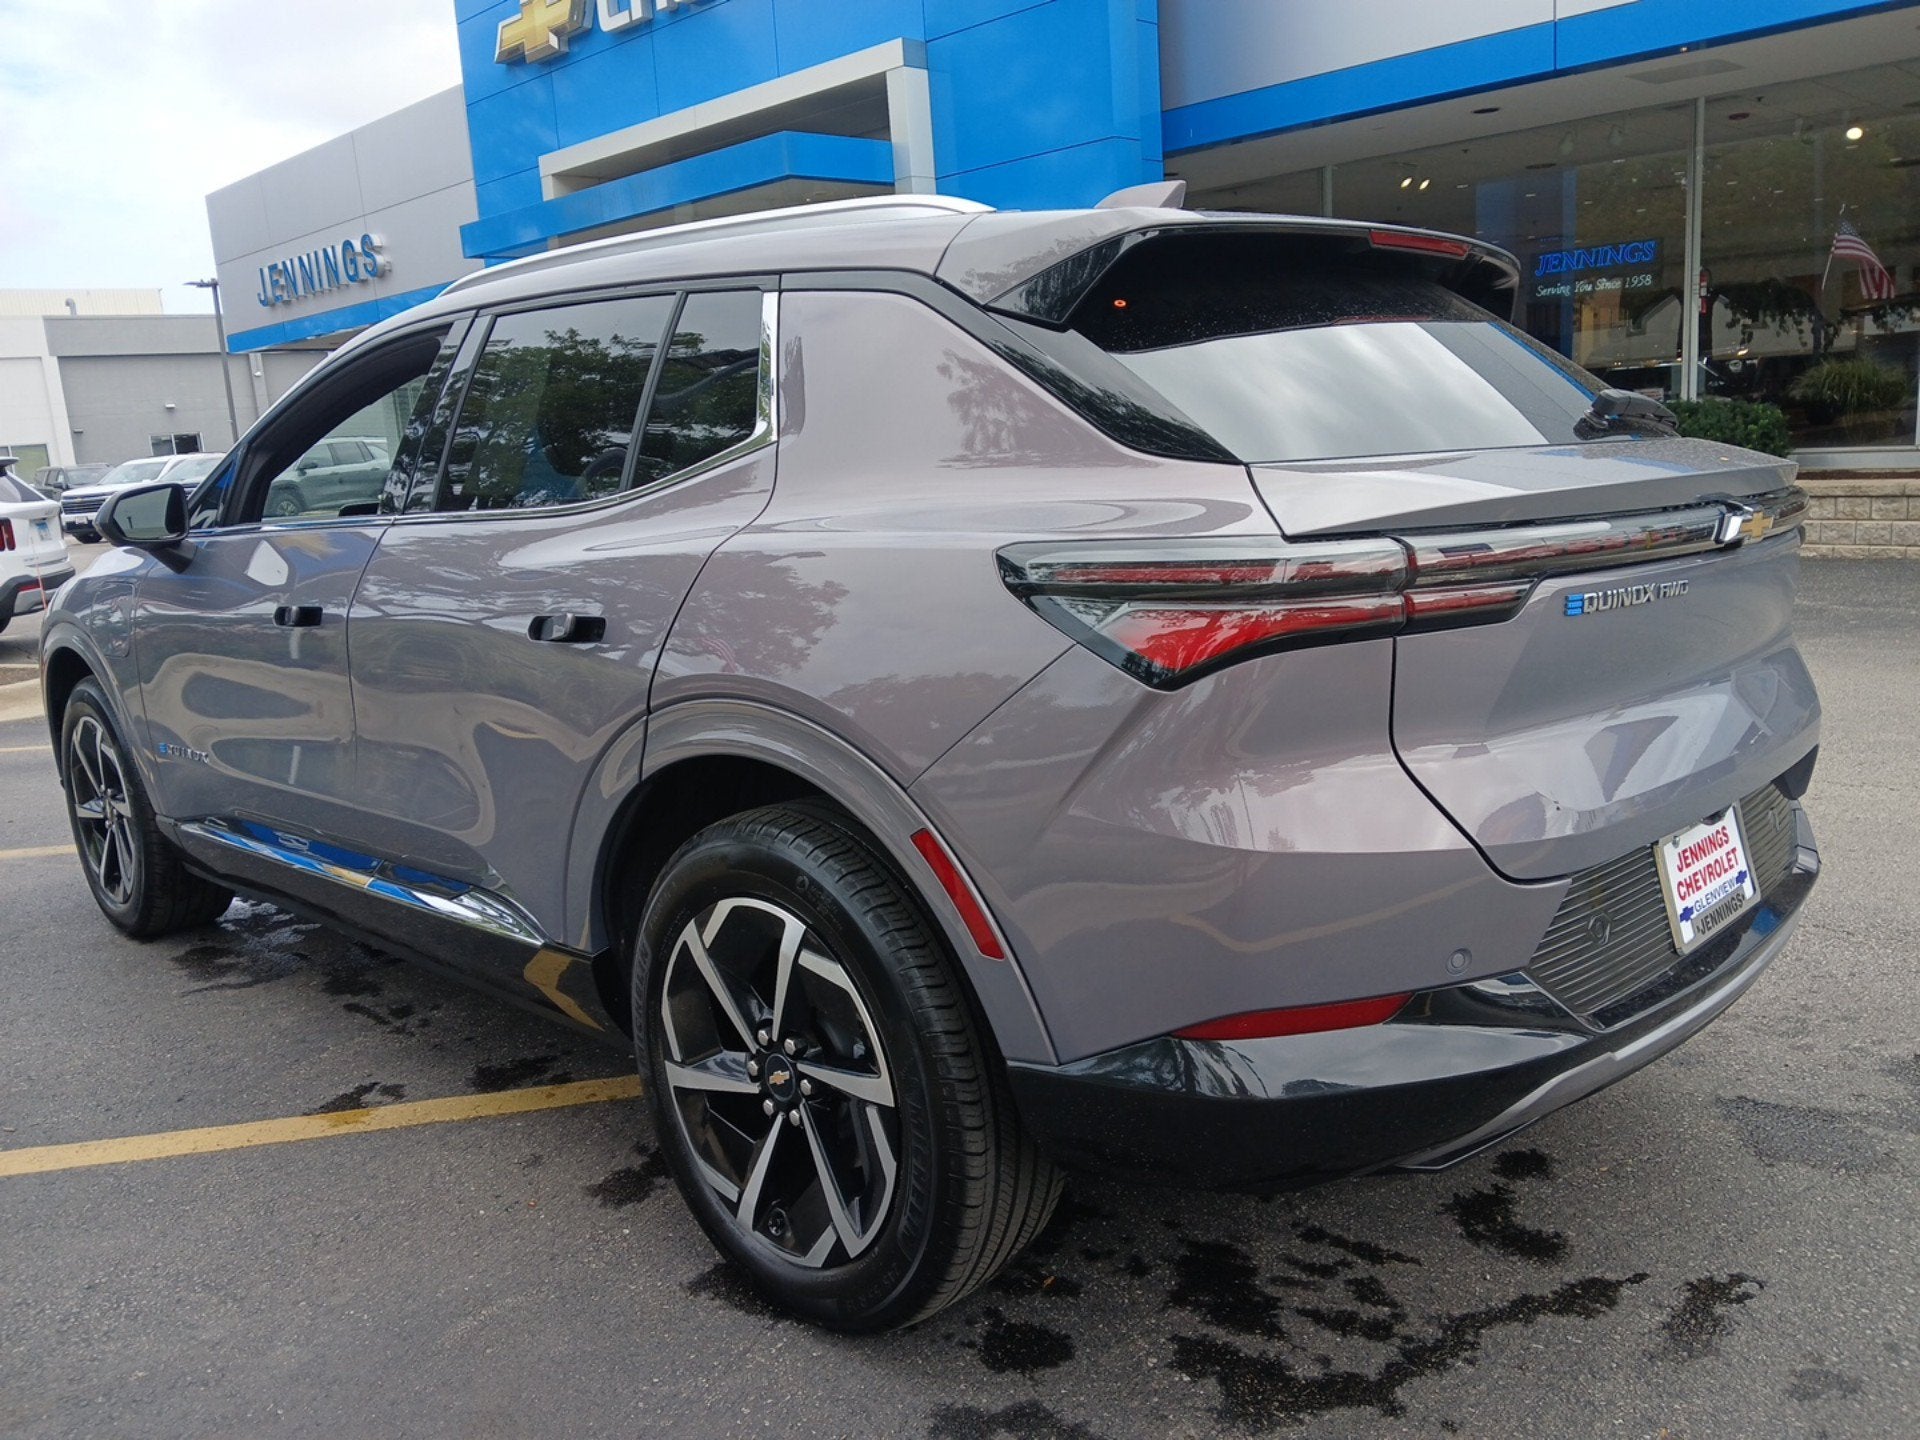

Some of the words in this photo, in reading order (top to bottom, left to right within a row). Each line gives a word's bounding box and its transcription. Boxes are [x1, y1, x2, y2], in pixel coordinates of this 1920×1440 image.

[257, 233, 382, 307] JENNINGS
[1535, 241, 1656, 276] JENNINGS
[1536, 283, 1571, 297] Serving
[1574, 280, 1593, 293] You
[1595, 277, 1621, 291] Since
[1625, 274, 1652, 288] 1958
[1564, 583, 1654, 616] EQUINOX
[1676, 825, 1730, 873] JENNINGS
[1676, 847, 1739, 901] CHEVROLET
[1693, 877, 1736, 913] GLENVIEW
[1699, 893, 1744, 936] JENNINGS
